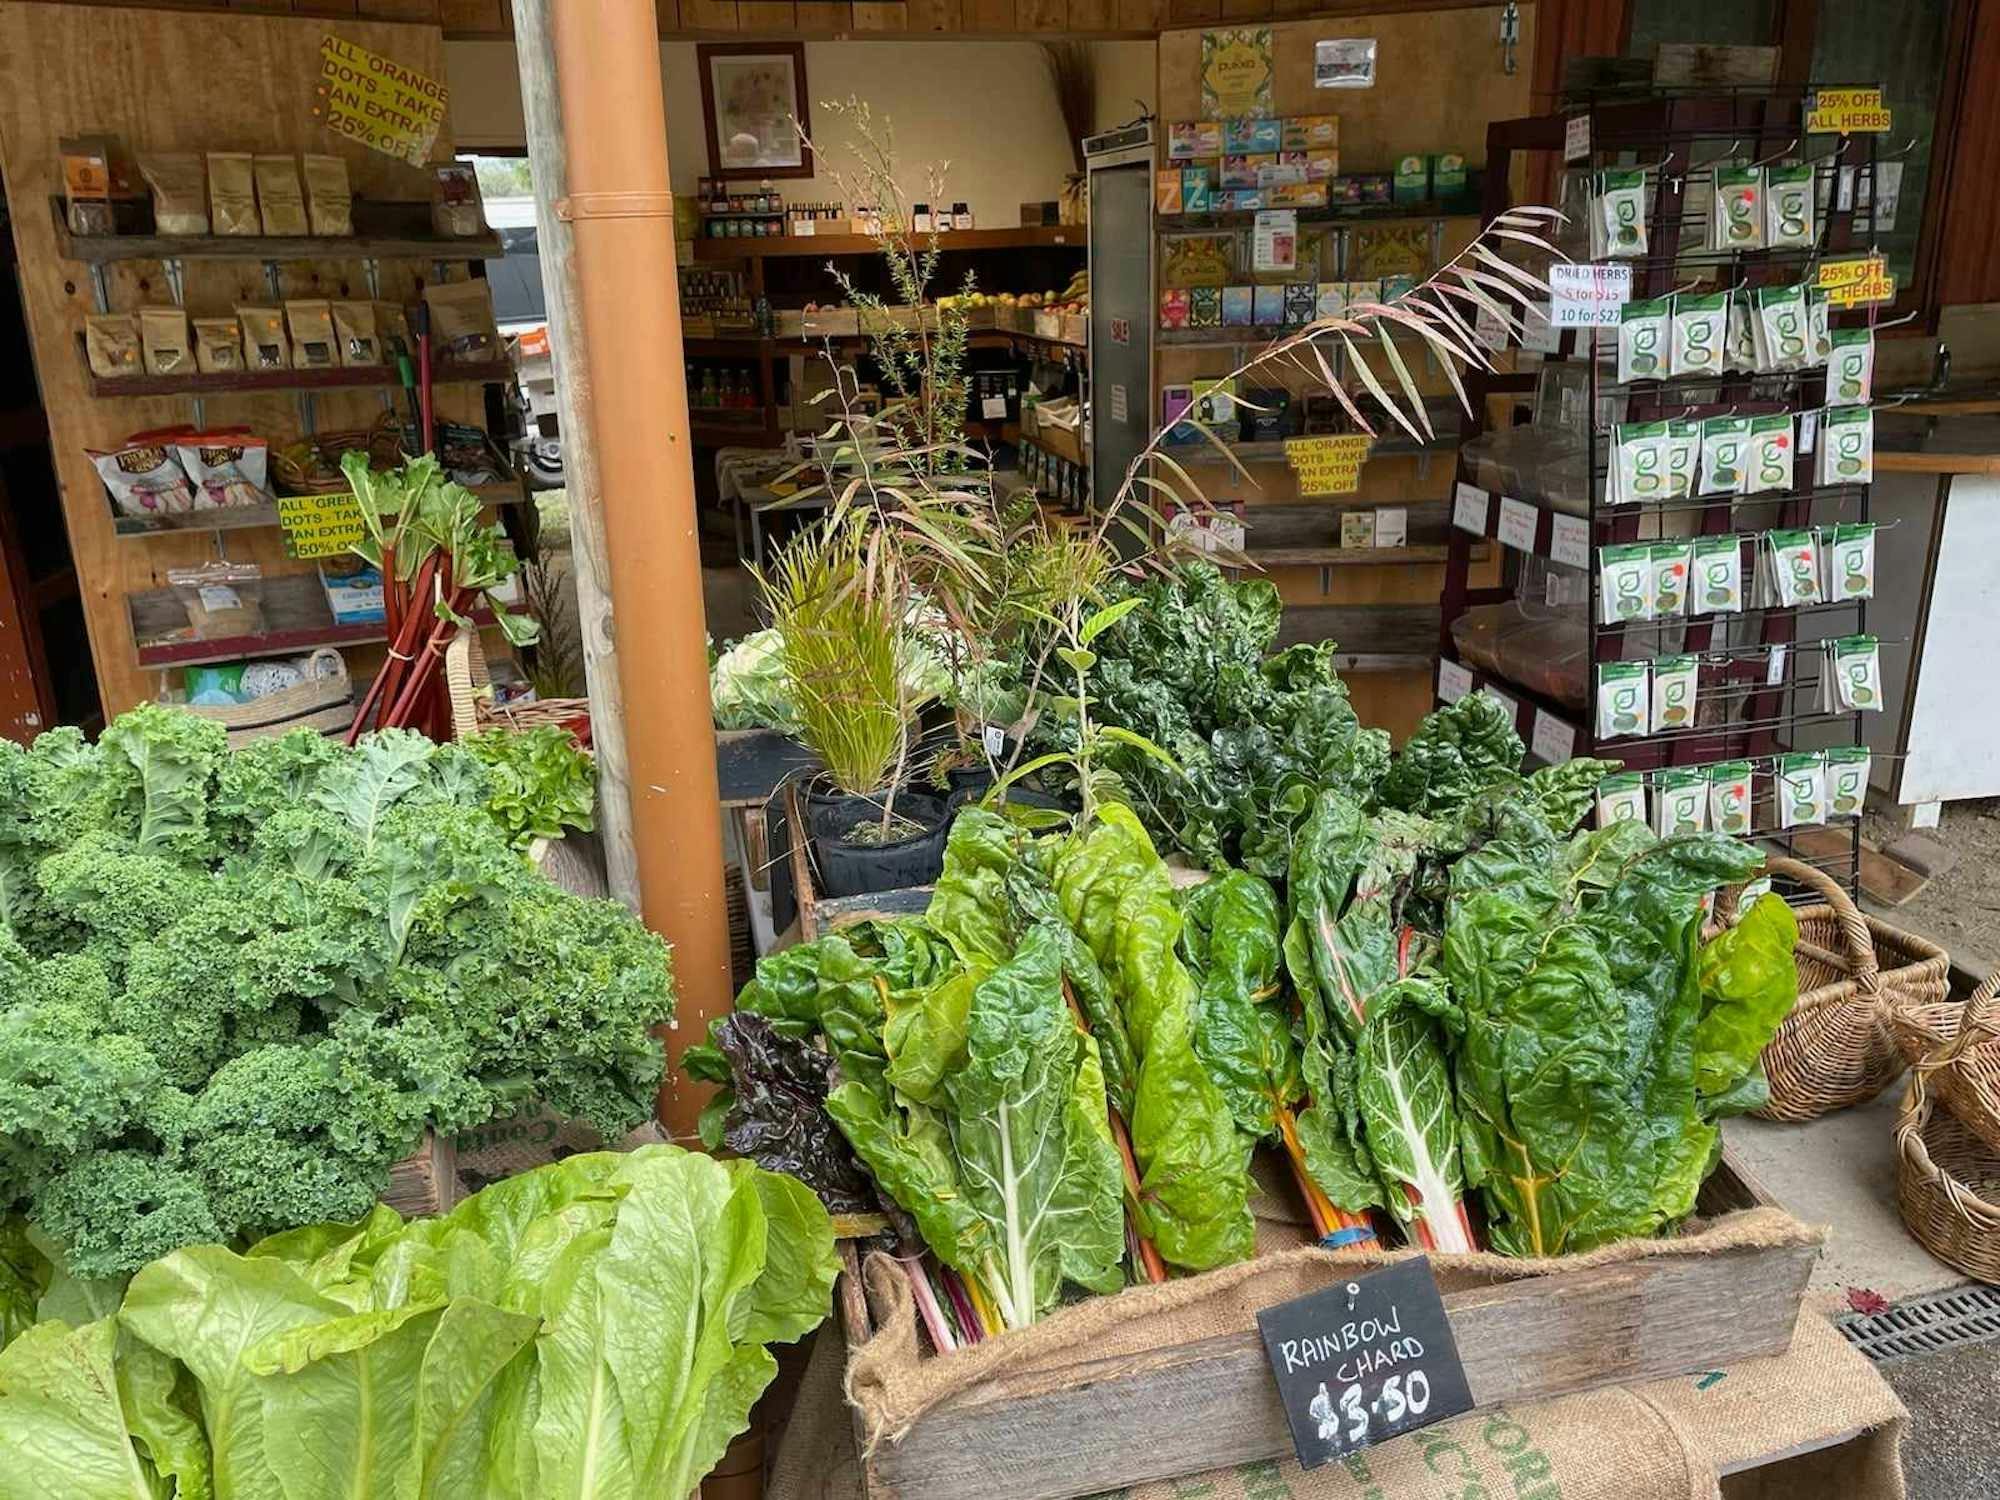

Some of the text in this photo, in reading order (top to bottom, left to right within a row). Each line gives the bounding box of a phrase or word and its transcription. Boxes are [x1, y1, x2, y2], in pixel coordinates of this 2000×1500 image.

[321, 37, 358, 63] ALL
[393, 89, 443, 123] TAKE
[1819, 93, 1880, 108] 25% OFF
[331, 87, 424, 136] AN EXTRA
[1808, 112, 1890, 128] ALL HERBS
[328, 110, 416, 160] 25% OFF
[1556, 268, 1628, 281] DRIED HERBS
[1821, 264, 1882, 282] 25% OFF
[1575, 288, 1593, 300] for
[1841, 281, 1891, 298] HERBS
[1560, 309, 1620, 323] 10 for $27
[1287, 441, 1308, 452] ALL
[1335, 450, 1365, 463] TAKE
[1301, 464, 1357, 478] AN EXTRA
[1303, 479, 1355, 492] 25% OFF
[280, 495, 357, 512] ALL 'GREE
[335, 510, 361, 521] TAK
[294, 523, 365, 540] AN EXTRA
[298, 542, 334, 556] 50%
[1281, 1305, 1401, 1374] RAINBOW
[1336, 1337, 1424, 1382] CHARD
[1309, 1369, 1430, 1442] $3.50
